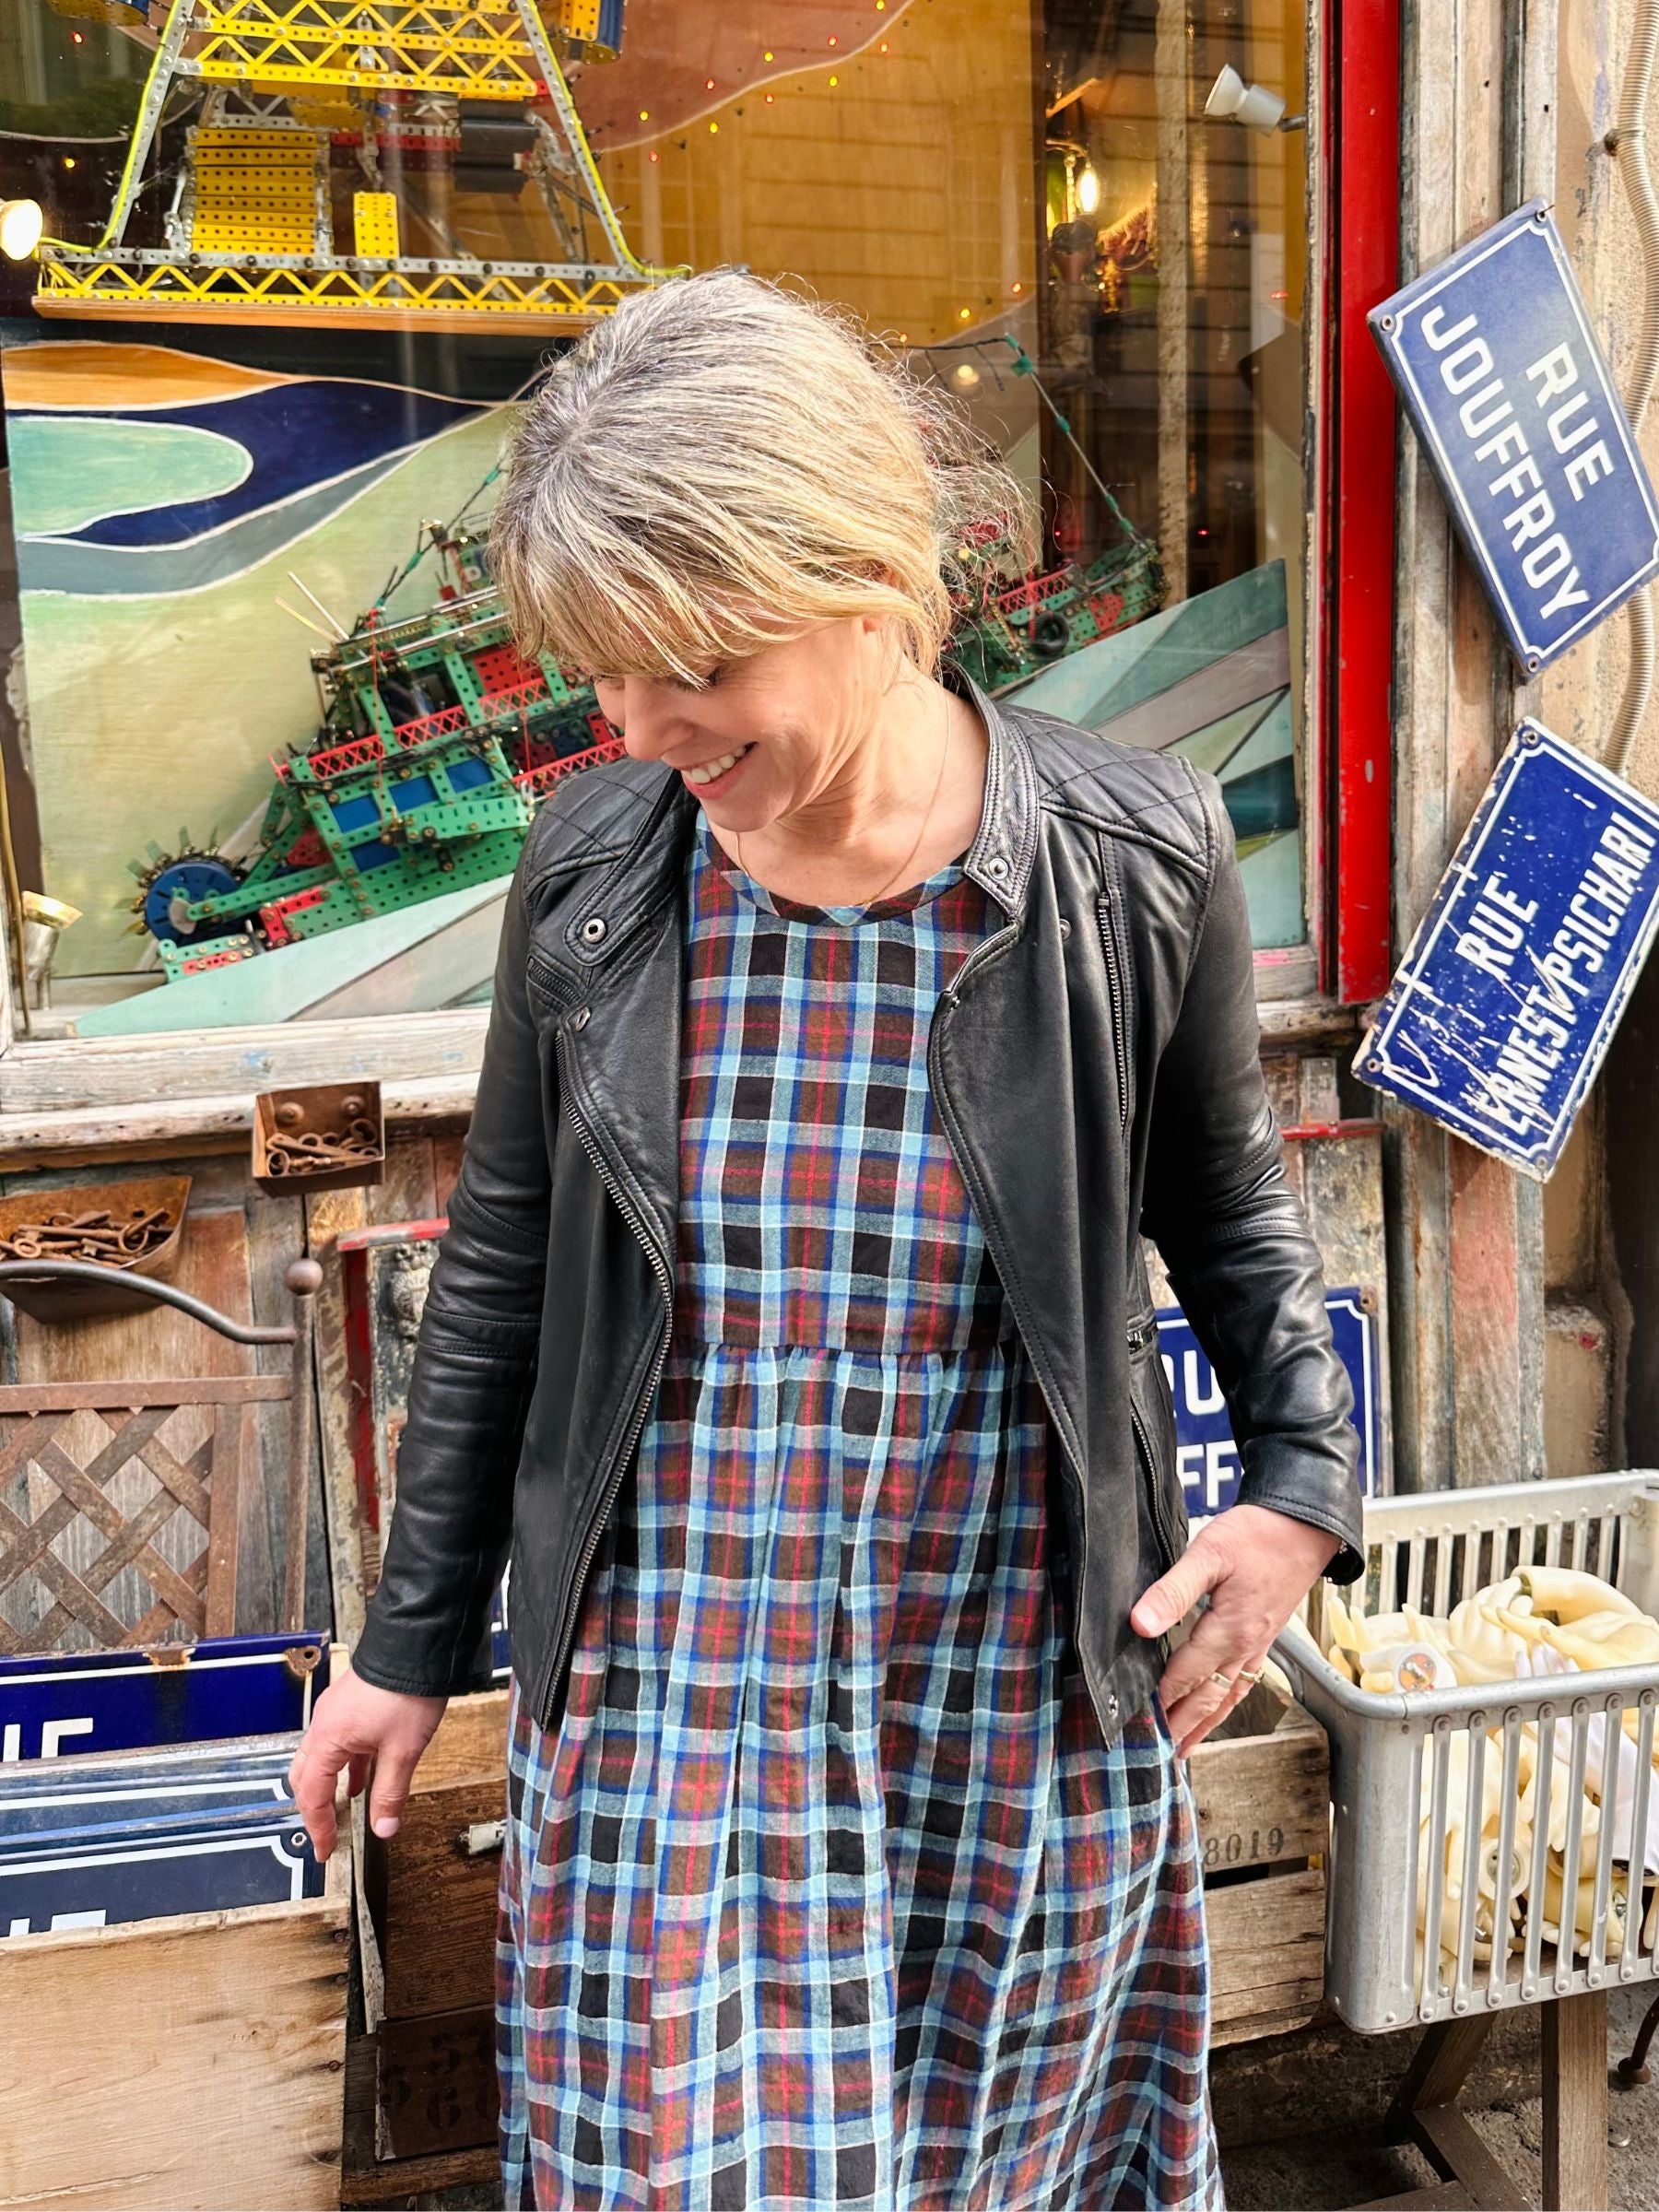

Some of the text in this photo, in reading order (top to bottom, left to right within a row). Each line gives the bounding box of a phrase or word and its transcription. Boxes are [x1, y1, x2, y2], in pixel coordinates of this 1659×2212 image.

[1420, 304, 1591, 620] JOUFFROY
[1526, 341, 1615, 502] RUE
[1454, 875, 1539, 981] RUE
[1474, 809, 1657, 1135] ERNEST PSICHARI
[1203, 1827, 1284, 1866] 8019
